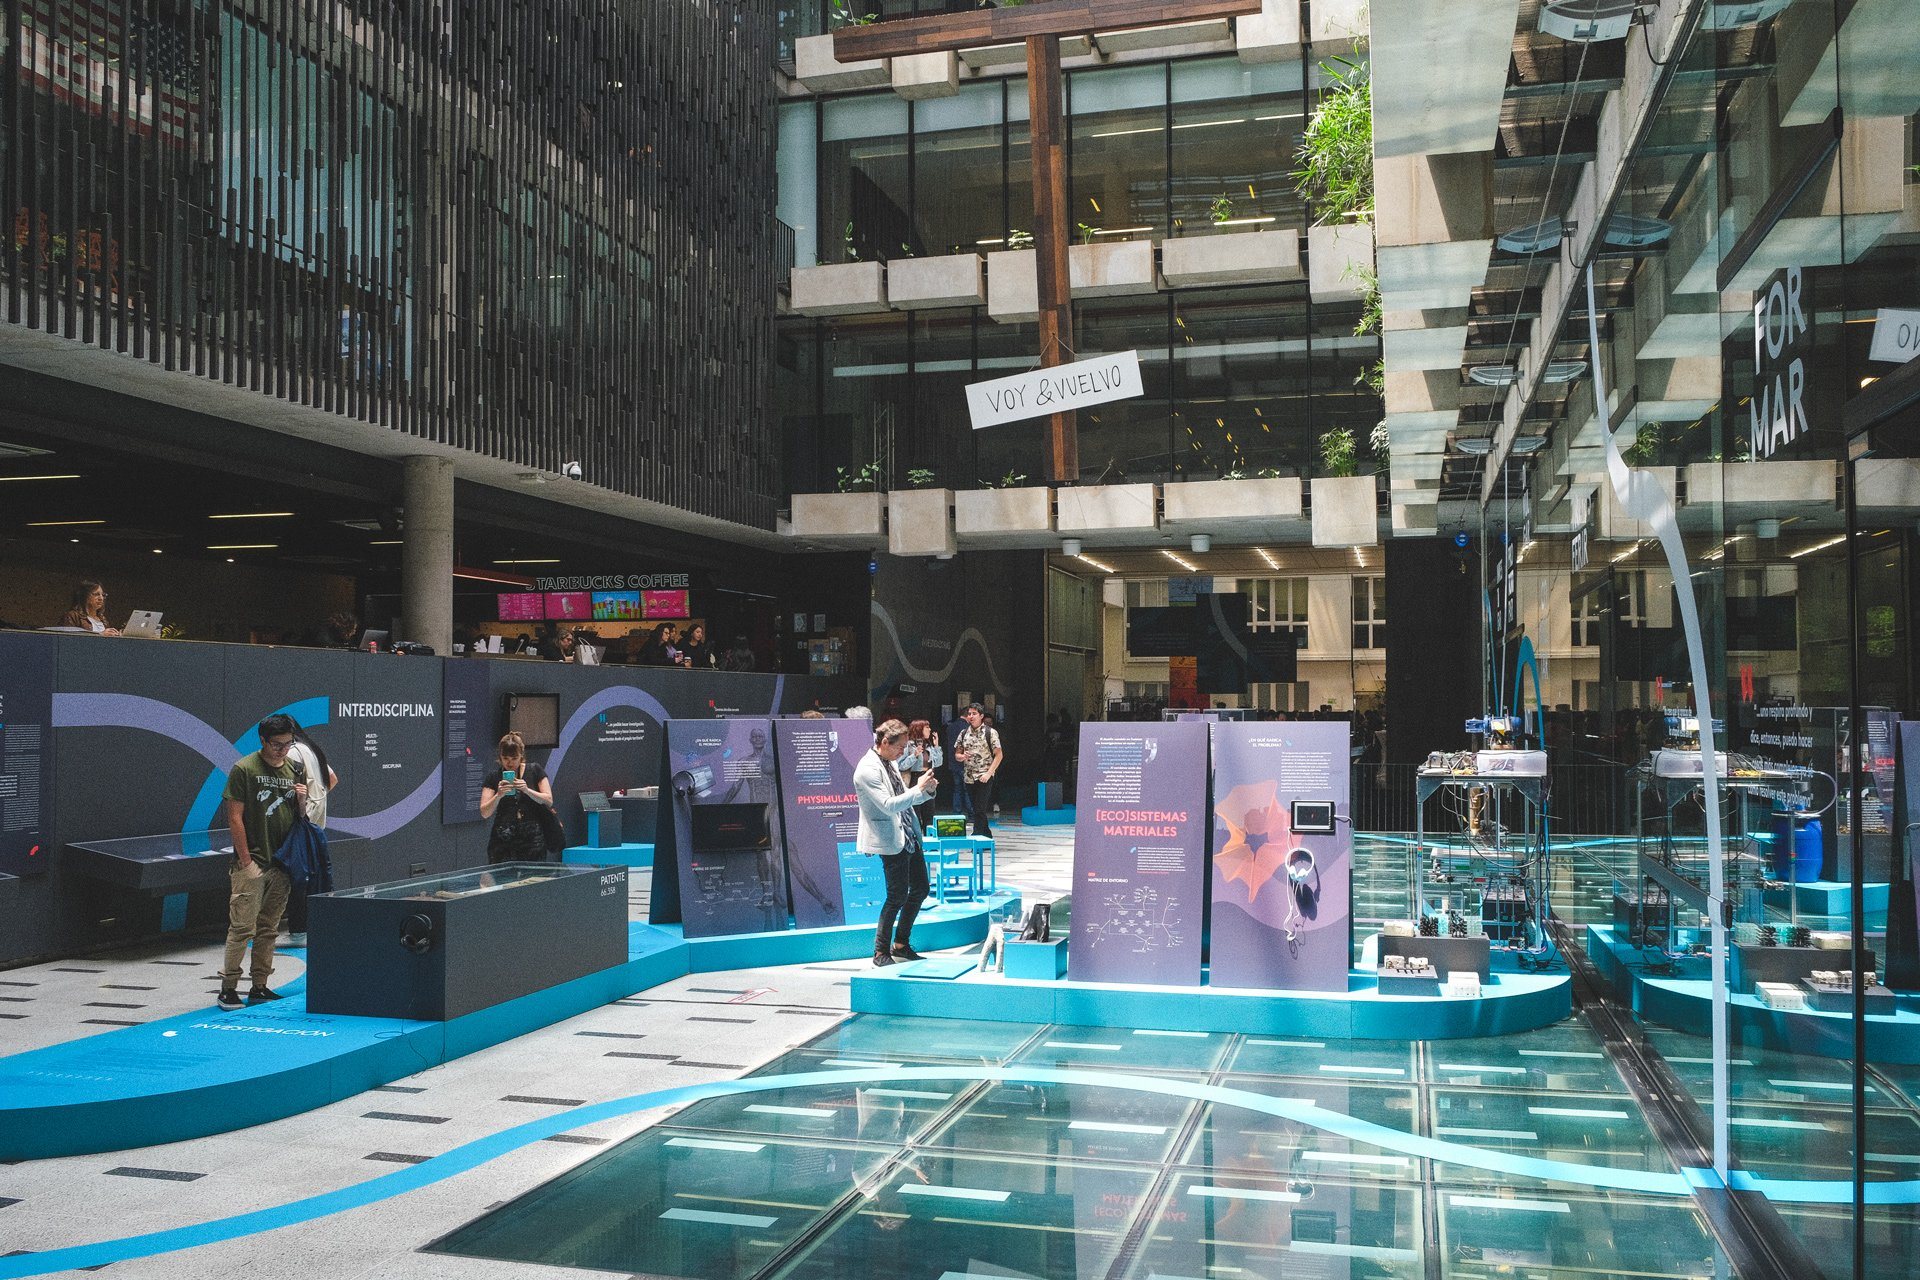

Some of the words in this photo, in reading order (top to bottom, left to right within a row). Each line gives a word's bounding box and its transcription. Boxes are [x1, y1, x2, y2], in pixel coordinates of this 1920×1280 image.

[1755, 264, 1807, 376] FOR
[986, 384, 1026, 413] VOY
[1751, 357, 1809, 464] MAR
[627, 573, 690, 588] COFFEE
[338, 703, 435, 717] INTERDISCIPLINA
[256, 775, 270, 783] THE
[1096, 809, 1187, 822] [ECO]SISTEMAS
[1104, 825, 1177, 837] MATERIALES
[600, 871, 625, 886] PATENTE
[600, 886, 616, 897] 66.358
[189, 1023, 336, 1037] INVESTIGACIÓN
